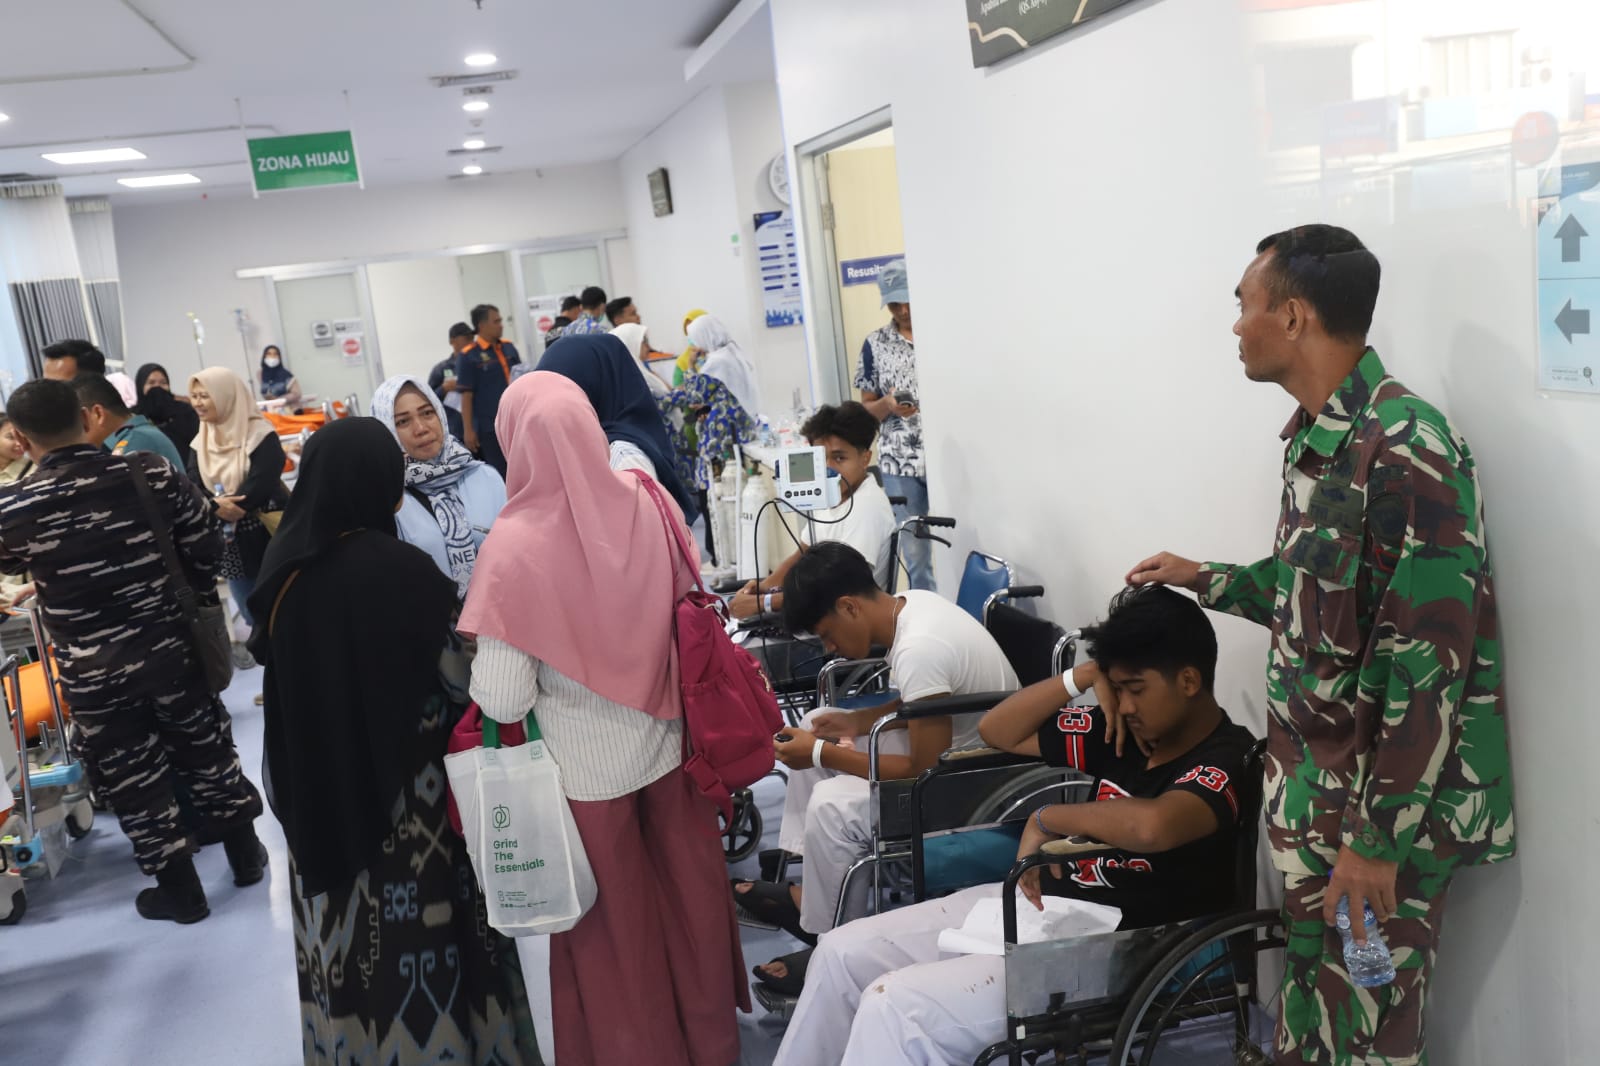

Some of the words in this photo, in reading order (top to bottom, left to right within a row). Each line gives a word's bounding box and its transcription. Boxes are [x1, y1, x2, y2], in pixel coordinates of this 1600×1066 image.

[256, 154, 303, 172] ZONA
[304, 149, 350, 167] HIJAU
[847, 264, 885, 278] Resusit
[493, 838, 518, 850] Grind
[494, 851, 514, 861] The
[494, 858, 545, 874] Essentials
